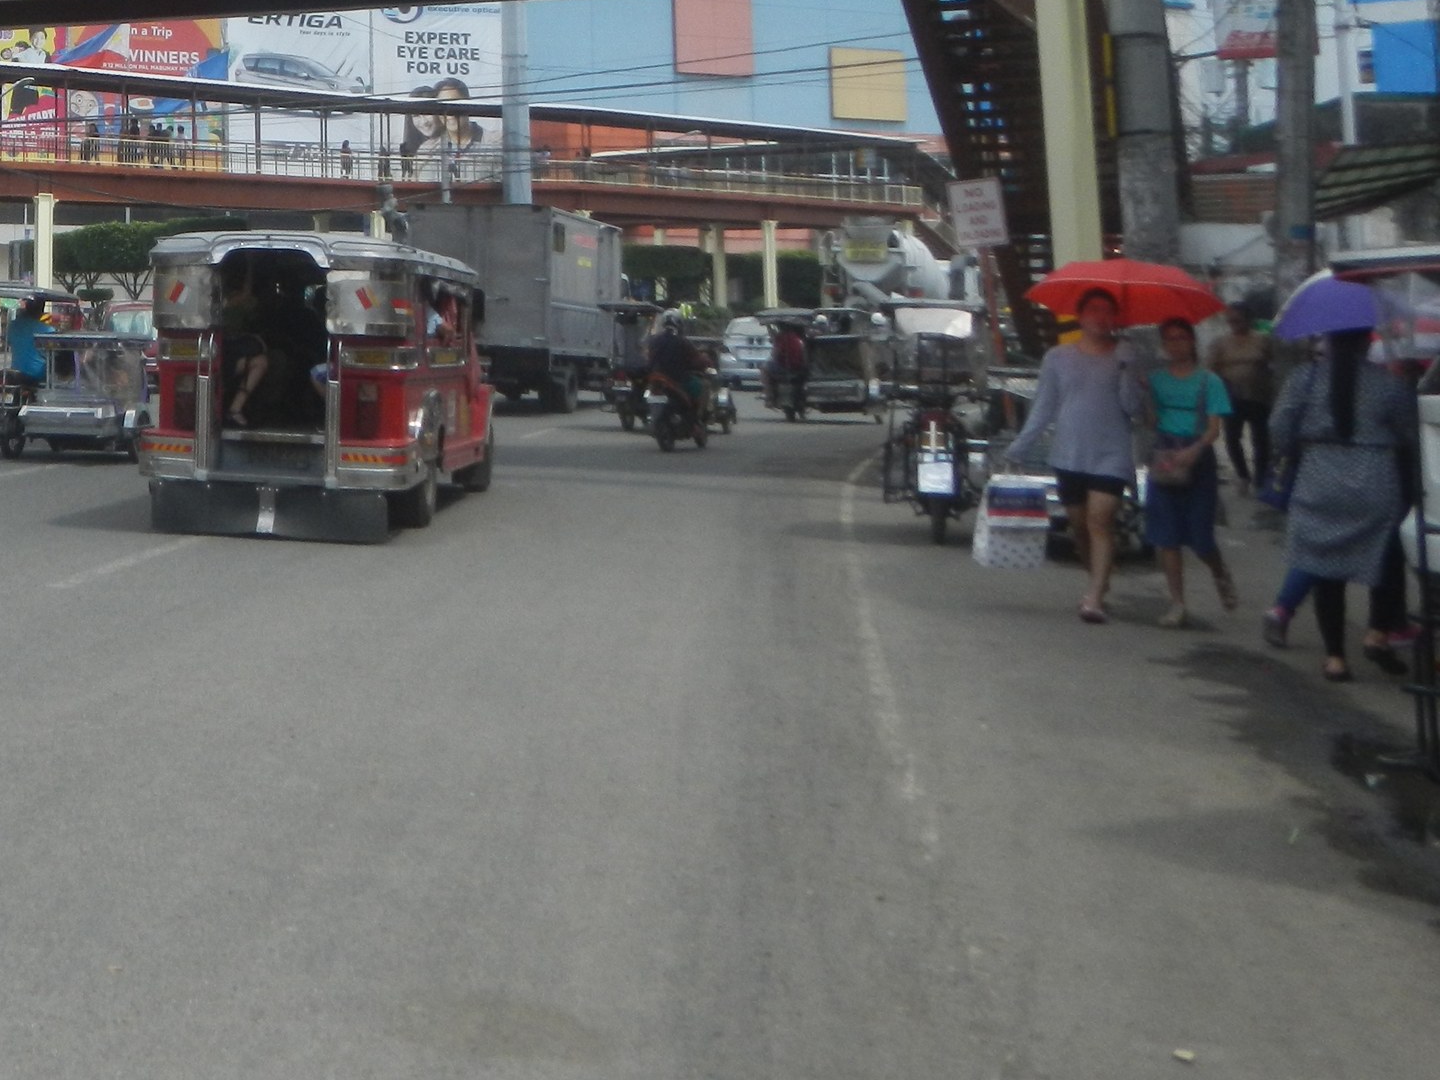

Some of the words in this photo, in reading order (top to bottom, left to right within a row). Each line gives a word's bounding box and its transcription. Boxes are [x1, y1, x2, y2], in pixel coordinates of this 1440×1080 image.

[248, 14, 343, 29] ERTIGA
[141, 28, 148, 36] a
[151, 26, 173, 39] Trip
[405, 31, 471, 45] EXPERT
[397, 46, 428, 59] EYE
[434, 47, 480, 61] CARE
[406, 61, 442, 74] FOR
[446, 62, 470, 75] US
